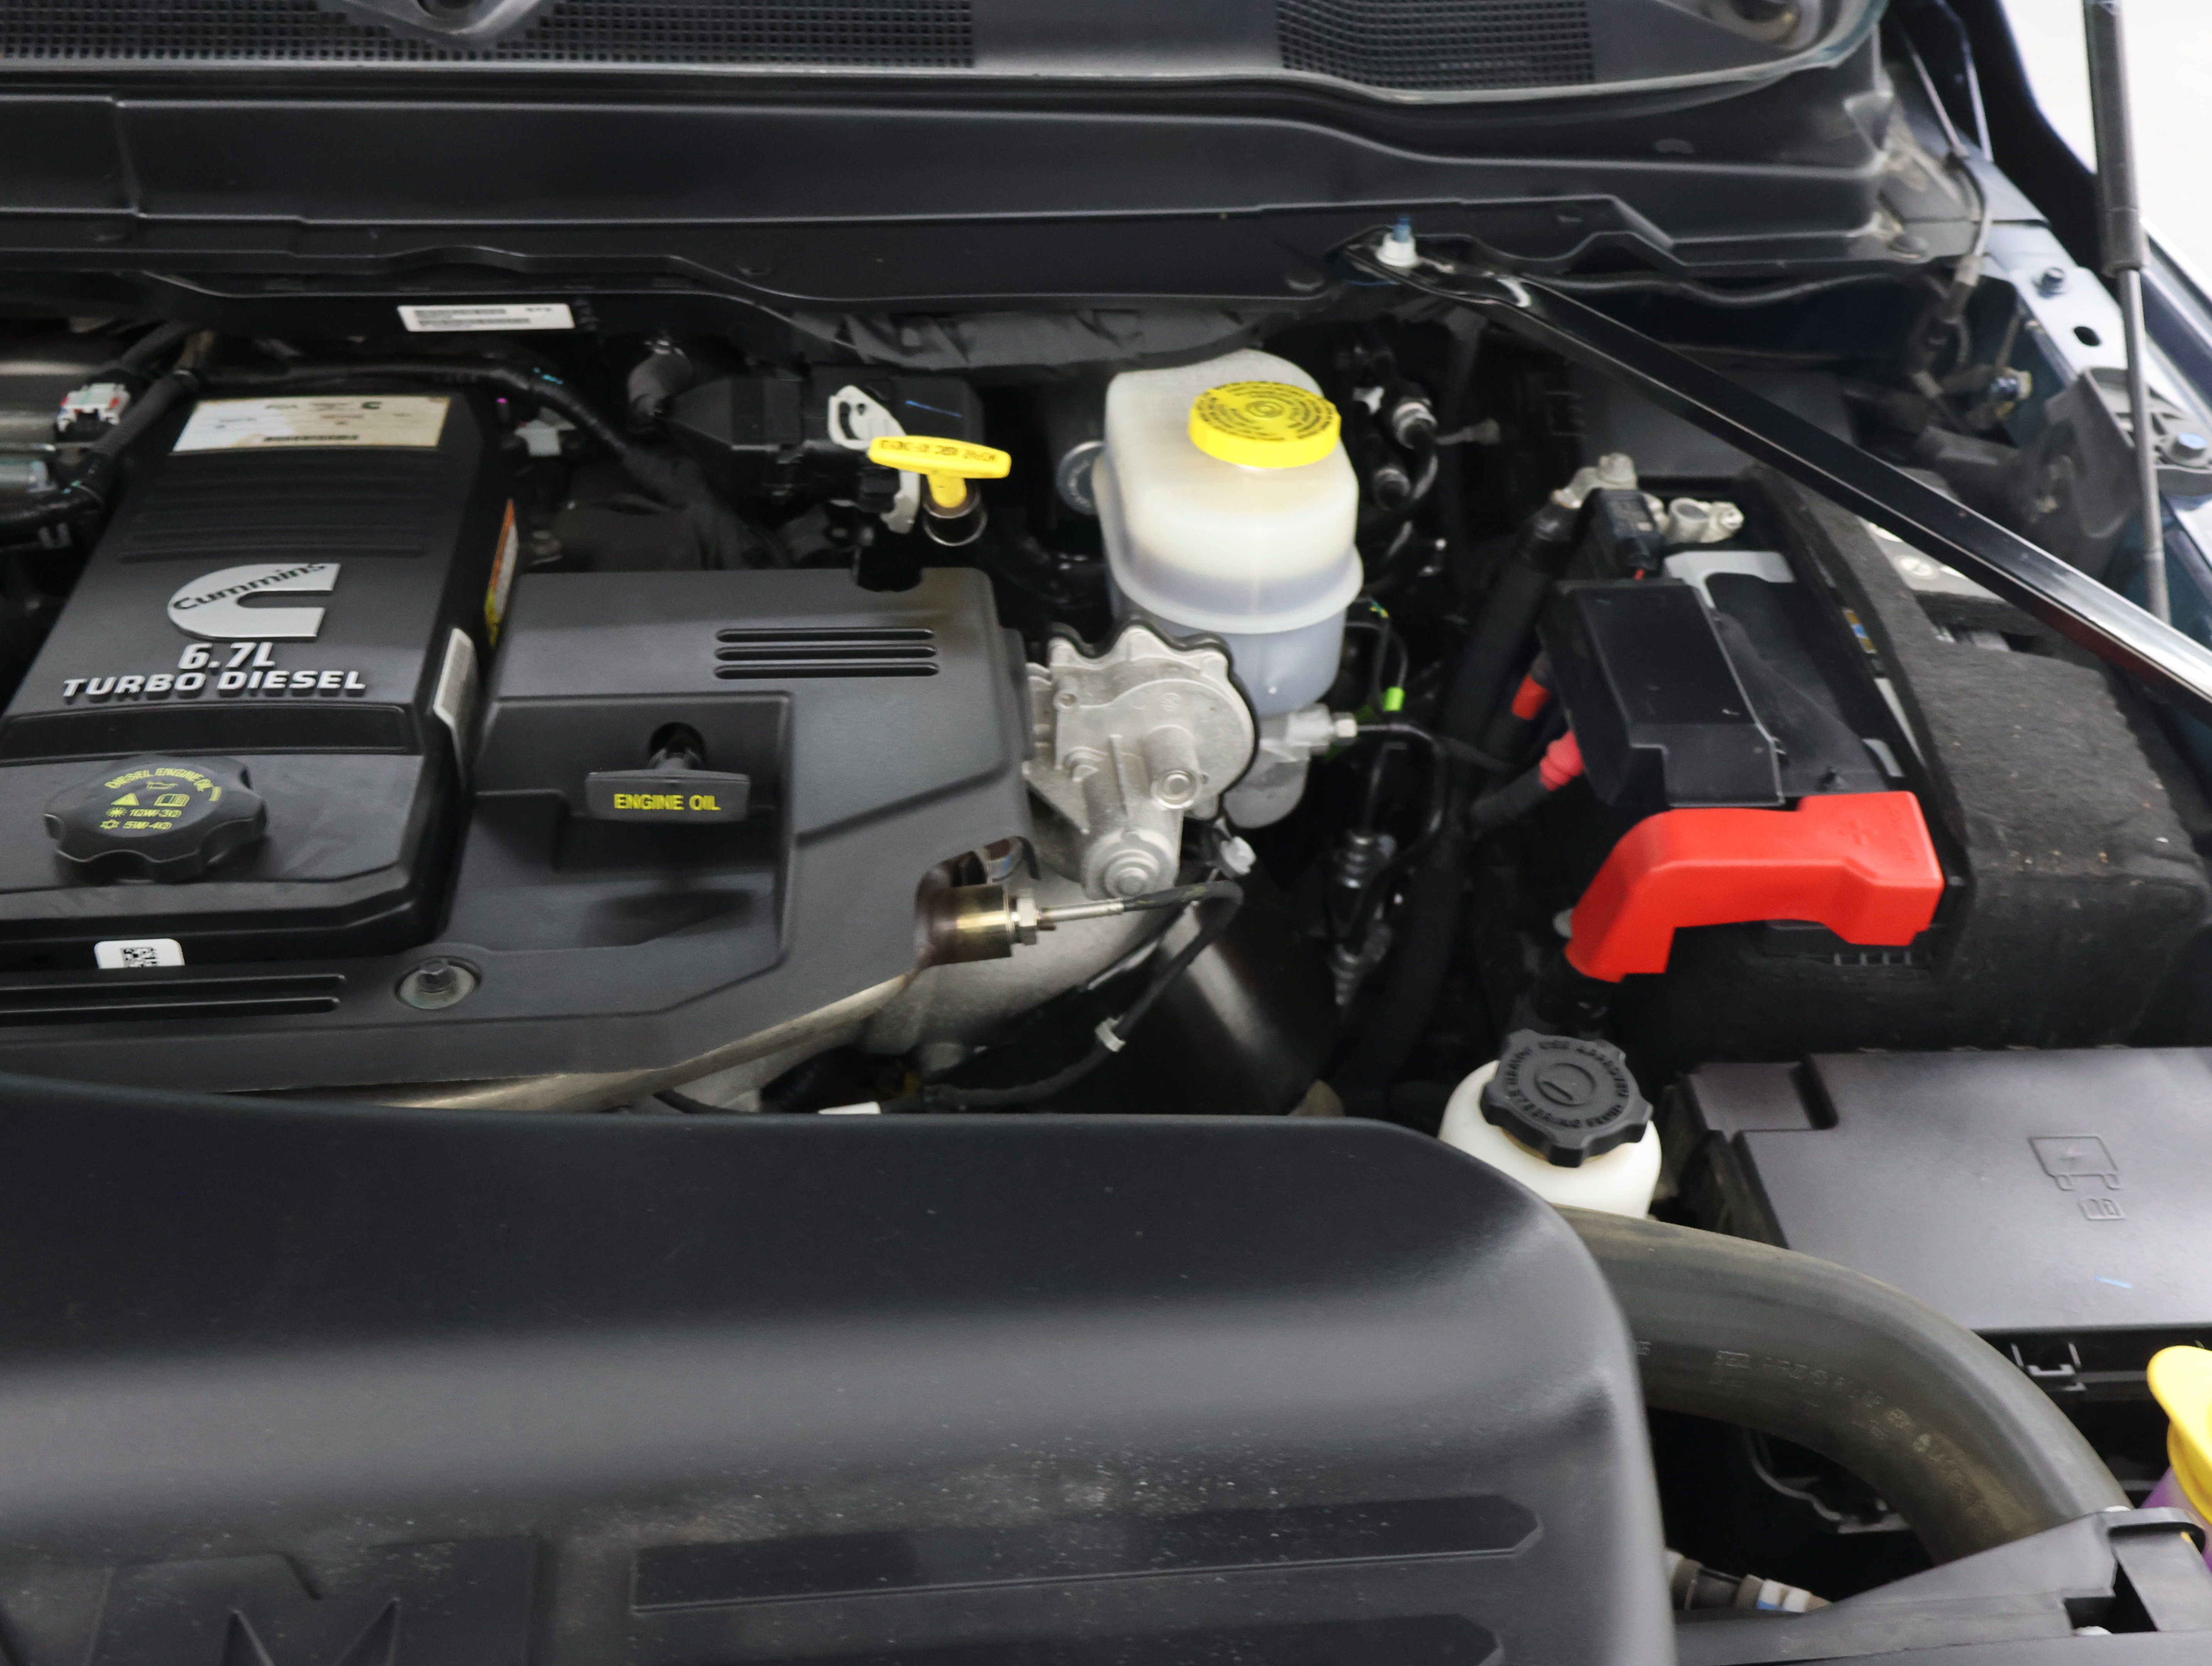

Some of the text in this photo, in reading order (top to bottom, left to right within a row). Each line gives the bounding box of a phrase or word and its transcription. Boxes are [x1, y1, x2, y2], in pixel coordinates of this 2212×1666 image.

[173, 563, 325, 609] Cummins
[178, 642, 276, 670] 6.7L
[63, 671, 366, 697] TURBO DIESEL
[154, 767, 204, 782] ENGINE
[614, 794, 722, 811] ENGINE OIL
